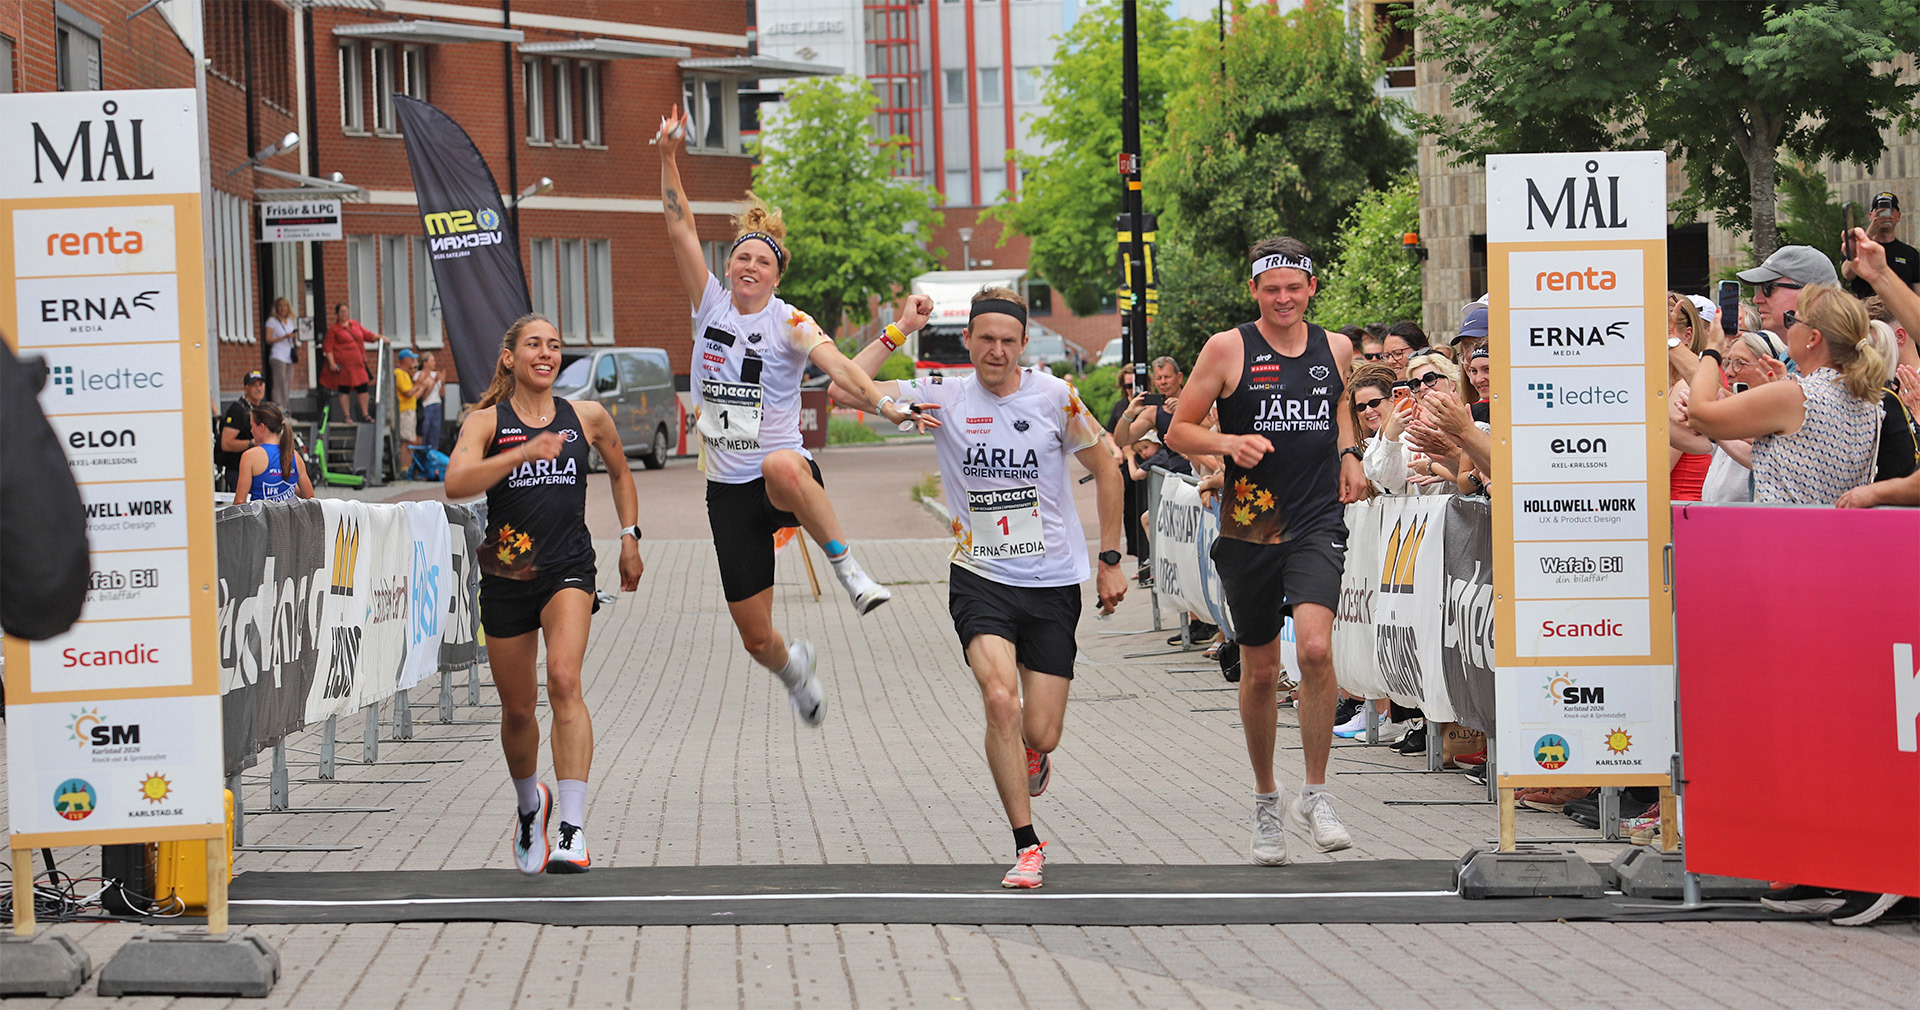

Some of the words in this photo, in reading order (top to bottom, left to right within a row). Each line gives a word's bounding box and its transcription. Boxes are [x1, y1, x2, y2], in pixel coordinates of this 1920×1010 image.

[31, 100, 154, 183] MÅL
[1526, 160, 1627, 230] MÅL
[266, 203, 300, 216] Frisör
[301, 204, 309, 215] &
[312, 203, 334, 215] LPG
[47, 226, 143, 256] renta
[1536, 267, 1617, 291] renta
[41, 296, 132, 323] ERNA
[70, 325, 104, 333] MEDIA
[1529, 326, 1605, 347] ERNA
[1251, 365, 1280, 373] BAUHAUS
[81, 369, 164, 391] ledtec
[1559, 386, 1629, 405] ledtec
[1254, 394, 1330, 420] JÄRLA
[719, 410, 729, 430] 1
[752, 410, 759, 420] 3
[1253, 420, 1330, 431] ORIENTERING
[726, 439, 760, 450] MEDIA
[963, 443, 1039, 468] JÄRLA
[963, 466, 1039, 479] ORIENTERING
[509, 476, 576, 488] ORIENTERING
[267, 487, 279, 495] IFK
[968, 489, 1037, 506] bagheera
[1524, 499, 1636, 513] HOLLOWELL.WORK
[123, 521, 156, 531] Design
[997, 516, 1009, 535] 1
[1032, 509, 1038, 517] 4
[1539, 516, 1551, 524] UX
[1553, 516, 1559, 524] &
[1561, 515, 1592, 523] Product
[1594, 514, 1622, 525] Design
[973, 546, 1000, 557] ERNA
[1010, 541, 1045, 555] MEDIA
[1540, 558, 1596, 574] Wafab
[1600, 556, 1624, 573] Bil
[130, 568, 159, 589] Bil
[1555, 574, 1569, 584] din
[1573, 574, 1608, 584] bilaffär!
[1542, 619, 1623, 637] Scandic
[63, 644, 160, 667] Scandic
[1563, 687, 1604, 704] SM
[91, 725, 140, 746] SM
[1448, 729, 1484, 739] OLIVE
[128, 808, 183, 817] KARLSTAD.SE
